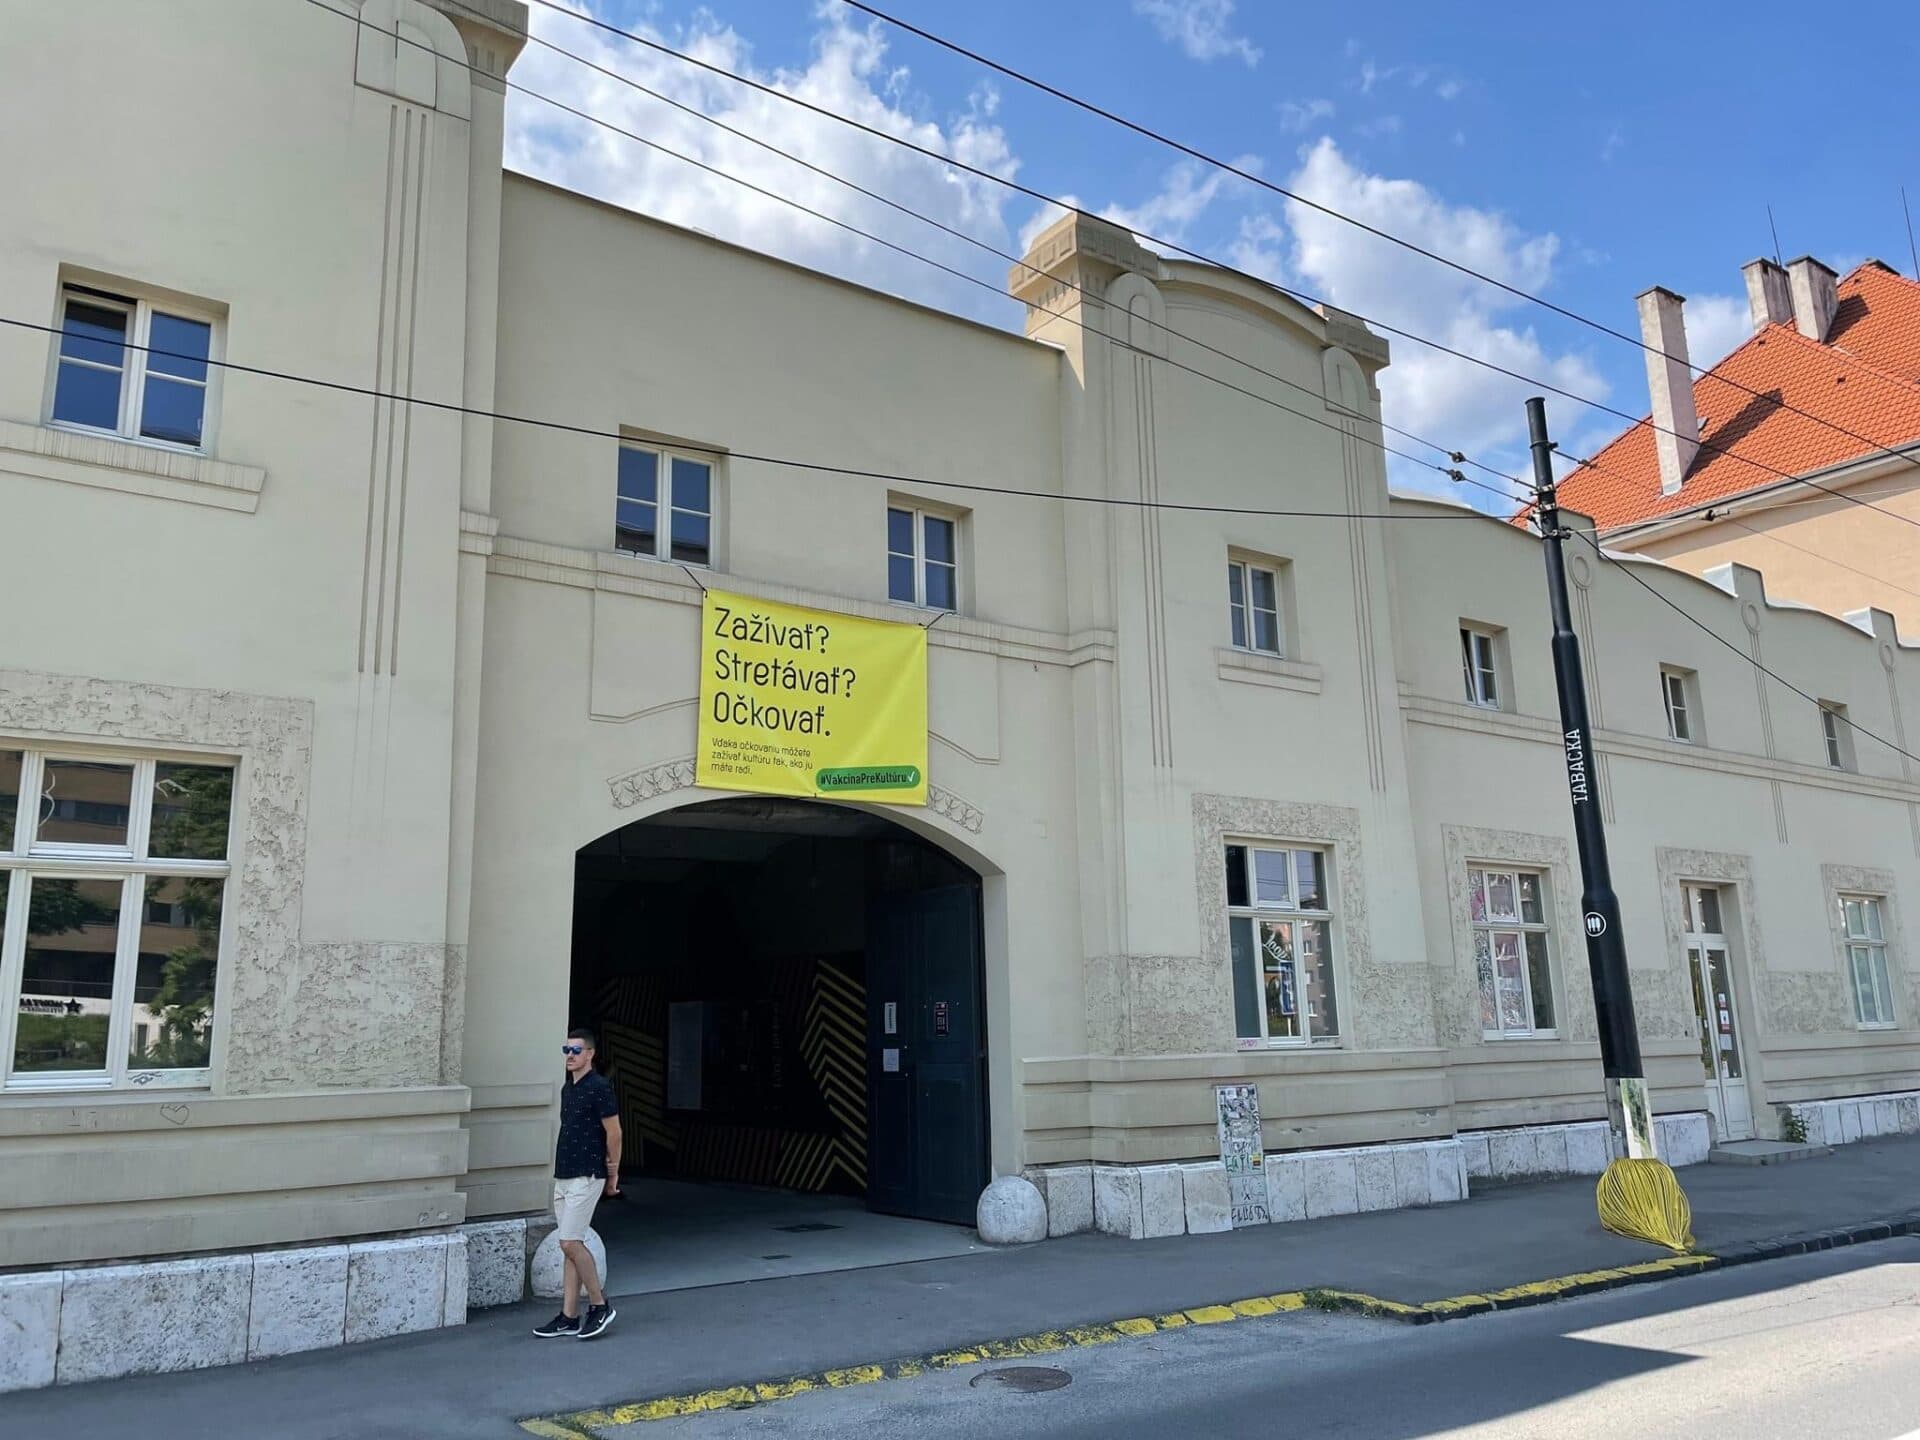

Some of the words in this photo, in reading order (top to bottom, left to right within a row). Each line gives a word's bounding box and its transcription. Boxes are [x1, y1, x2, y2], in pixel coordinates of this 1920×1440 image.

[714, 606, 830, 654] Zažívať?
[715, 649, 856, 698] Stretávať?
[713, 691, 831, 737] Očkovať.
[805, 761, 813, 771] ju
[820, 771, 907, 785] #VakcinaPreKultúru
[1565, 728, 1588, 804] TABACKA
